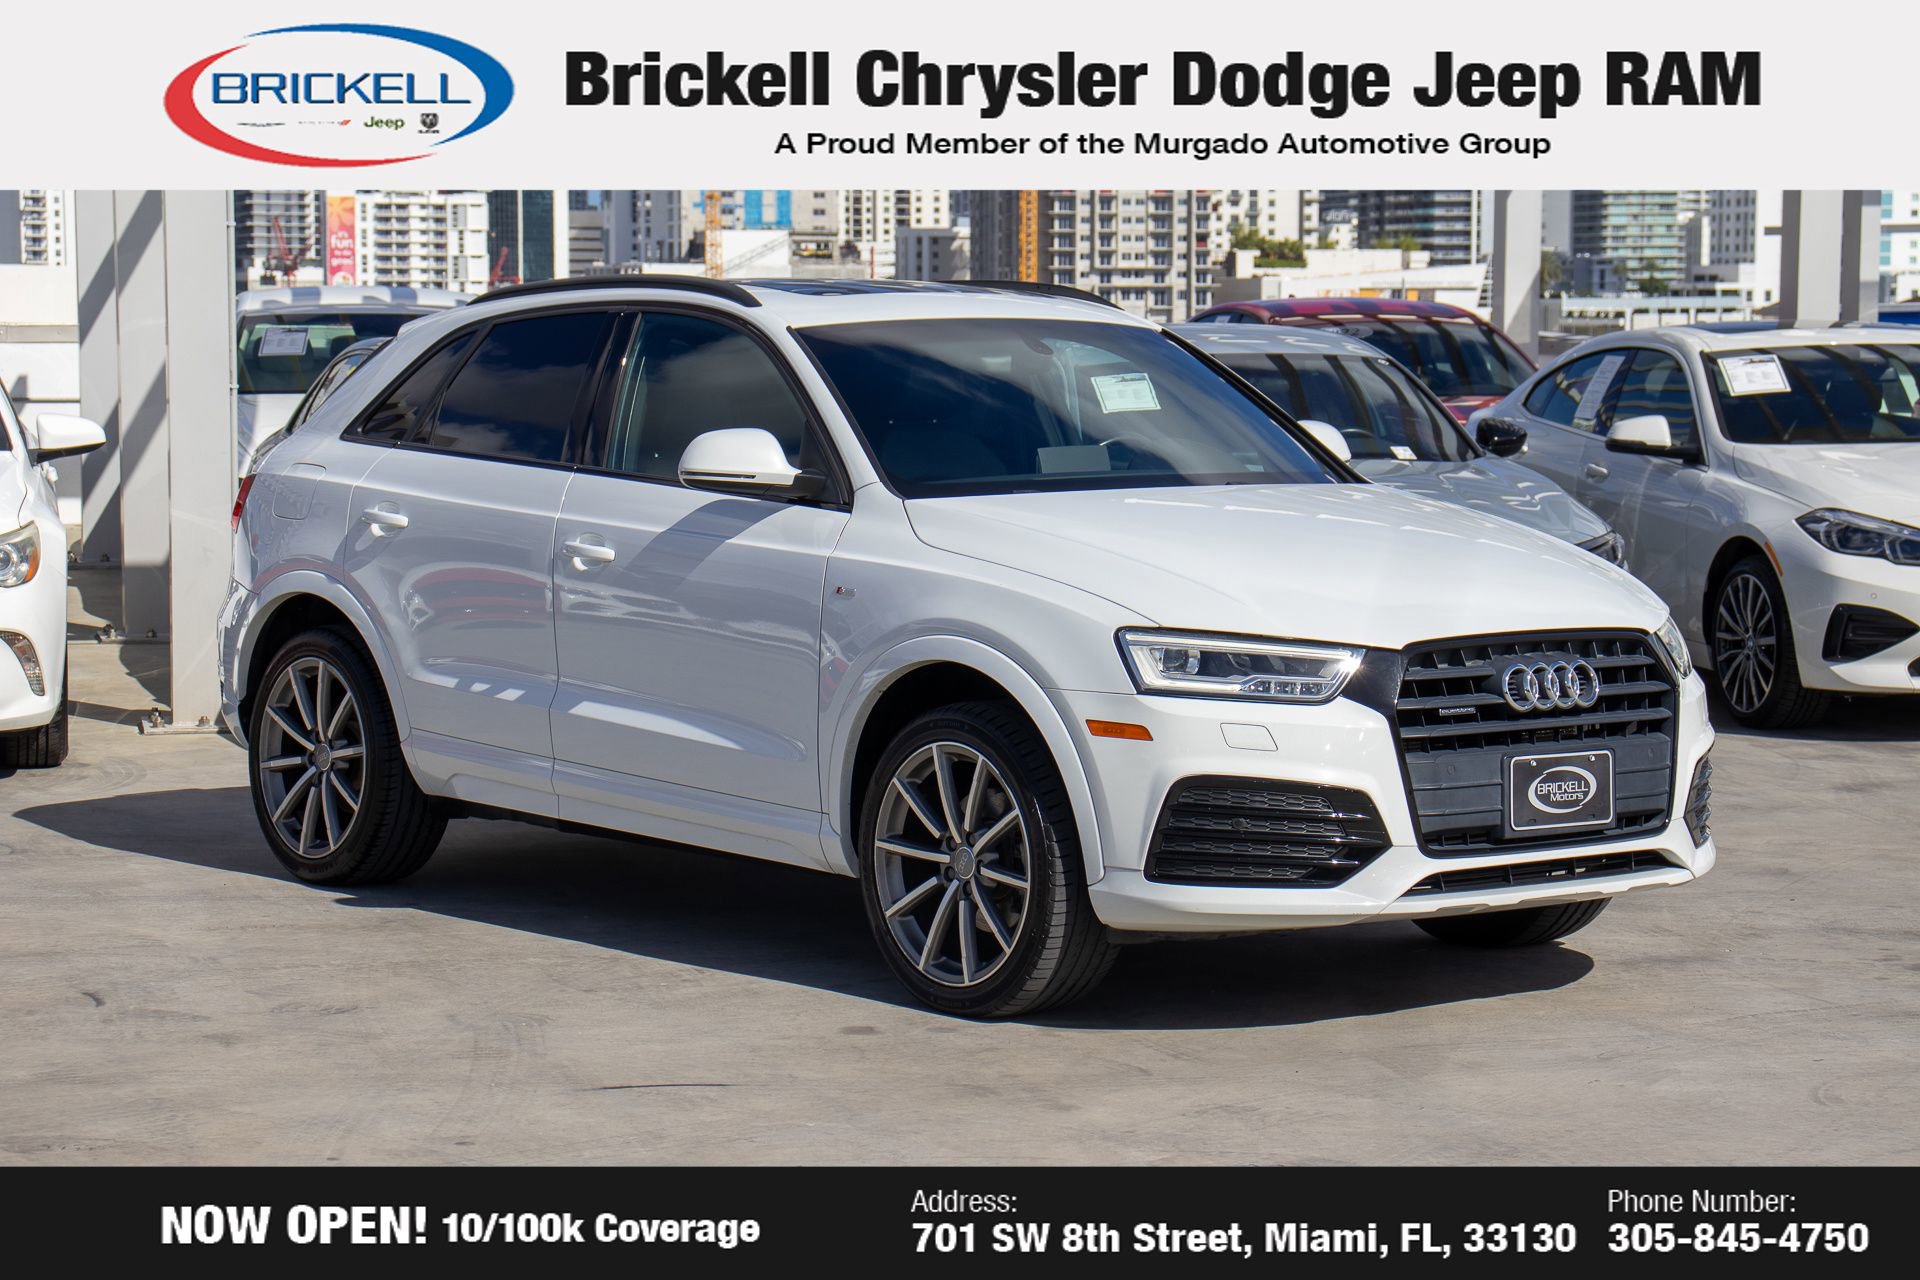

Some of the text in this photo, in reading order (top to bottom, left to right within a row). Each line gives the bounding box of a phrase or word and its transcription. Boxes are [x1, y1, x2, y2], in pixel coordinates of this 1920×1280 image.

[330, 234, 354, 249] fun
[1537, 780, 1589, 795] BRICKELL
[1550, 792, 1584, 802] Motors
